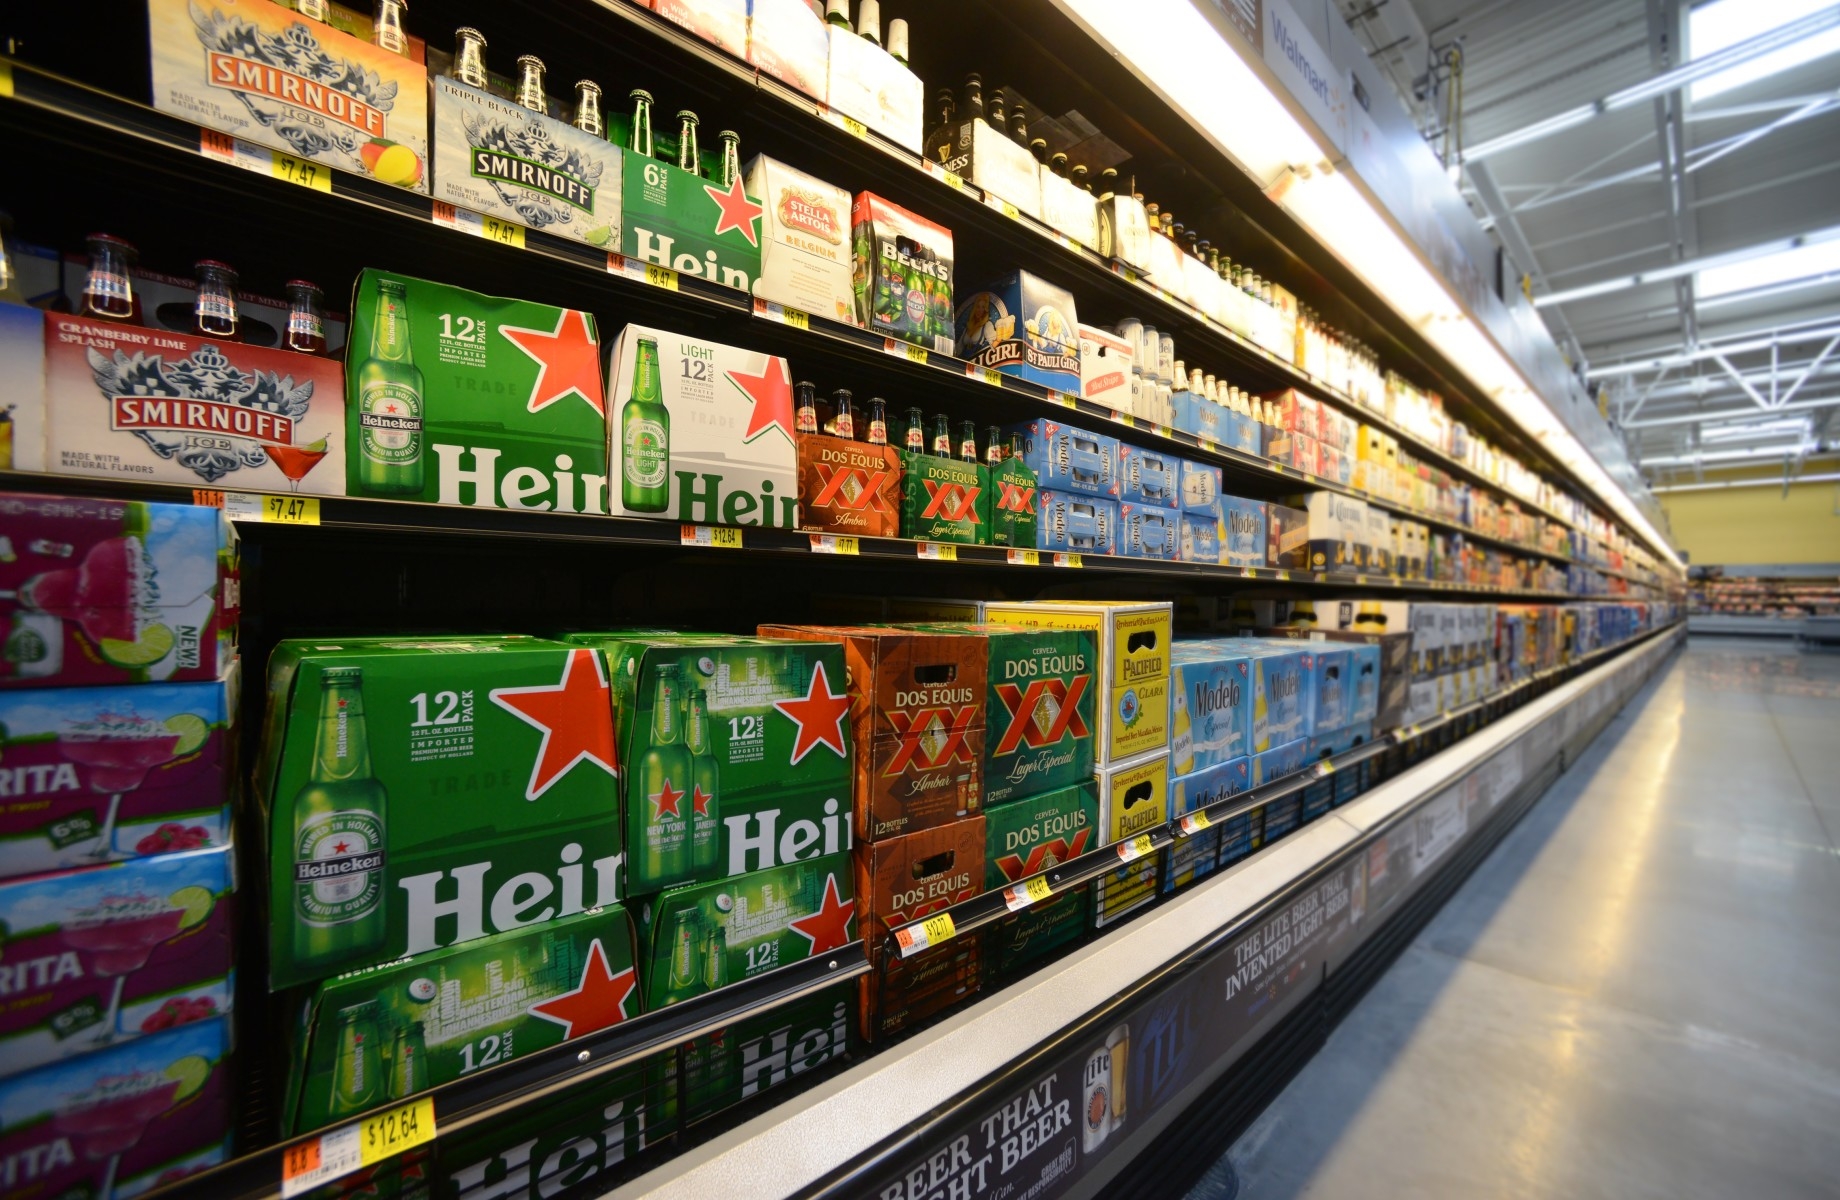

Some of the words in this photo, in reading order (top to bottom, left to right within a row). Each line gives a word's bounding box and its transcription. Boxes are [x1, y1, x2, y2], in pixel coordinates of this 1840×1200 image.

[661, 6, 696, 34] Berries
[1270, 10, 1330, 107] Walmart
[216, 57, 381, 134] SMIRNOFF
[443, 84, 484, 106] TRIPLE
[487, 99, 524, 121] BLACK
[281, 104, 326, 129] ICE
[281, 157, 317, 187] $7.47
[477, 153, 590, 205] SMIRNOFF
[643, 163, 660, 186] 6
[660, 168, 668, 191] PACK
[521, 188, 551, 206] ICE
[790, 200, 831, 224] STELLA
[790, 211, 831, 235] ARTOIS
[488, 220, 515, 244] $7.47
[785, 234, 838, 261] BELGIUM
[58, 321, 152, 346] CRANBERRY
[154, 336, 188, 351] LIME
[58, 331, 117, 350] SPLASH
[438, 313, 476, 343] 12
[476, 319, 487, 345] PACK
[439, 346, 486, 359] IMPORTED
[681, 343, 714, 361] LIGHT
[985, 342, 1021, 366] GIRL
[1037, 353, 1061, 369] PAULI
[1060, 354, 1081, 374] GIRL
[680, 357, 707, 382] 12
[453, 375, 517, 396] TRADE
[121, 400, 288, 440] SMIRNOFF
[362, 414, 421, 430] Heineken
[690, 410, 735, 429] TRADE
[185, 434, 233, 450] ICE
[626, 446, 666, 459] Heineken
[1059, 433, 1070, 476] Modelo
[60, 450, 92, 462] MADE
[94, 453, 121, 463] WITH
[60, 458, 108, 471] NATURAL
[111, 461, 155, 475] FLAVORS
[821, 448, 848, 464] DOS
[850, 454, 885, 470] EQUIS
[1101, 445, 1109, 485] Modelo
[928, 466, 949, 481] DOS
[951, 471, 979, 485] EQUIS
[1003, 473, 1015, 486] DOS
[1014, 475, 1035, 488] EQUIS
[1131, 455, 1140, 492] Modelo
[811, 462, 889, 514] XX
[919, 478, 982, 525] XX
[996, 480, 1036, 514] XX
[270, 498, 305, 521] $7.47
[830, 512, 869, 527] Ambar
[1056, 500, 1066, 544] Modelo
[1229, 509, 1262, 536] Modelo
[946, 523, 972, 537] Especial
[1097, 507, 1106, 548] Modelo
[1132, 514, 1141, 553] Modelo
[179, 625, 198, 669] NEW!
[1032, 647, 1058, 656] CERVEZA
[1005, 659, 1038, 680] DOS
[1041, 654, 1086, 675] EQUIS
[1122, 657, 1162, 681] PACIFICO
[895, 690, 928, 708] DOS
[931, 687, 974, 705] EQUIS
[1138, 686, 1164, 701] CLARA
[1194, 678, 1241, 720] Modelo
[409, 690, 460, 728] 12
[461, 689, 474, 723] PACK
[663, 696, 671, 734] Heineken
[992, 673, 1093, 758] XX
[335, 710, 347, 758] Heineken
[443, 725, 474, 734] BOTTLES
[728, 715, 757, 741] 12
[756, 715, 764, 738] PACK
[881, 703, 980, 778] XX
[411, 736, 474, 749] IMPORTED
[1005, 753, 1040, 785] Lager
[1036, 746, 1077, 776] Especial
[429, 768, 513, 797] TRADE
[904, 773, 952, 797] Ambar
[986, 791, 996, 803] 12
[995, 786, 1013, 797] BOTTLES
[874, 822, 887, 836] 12
[886, 817, 909, 828] BOTTLES
[1034, 807, 1060, 821] CERVEZA
[1118, 805, 1159, 838] PACIFICO
[301, 825, 330, 855] BREWED
[332, 821, 344, 831] IN
[346, 820, 379, 845] HOLLAND
[646, 824, 665, 837] NEW
[666, 820, 687, 834] YORK
[723, 796, 853, 878] Hei
[1006, 825, 1040, 851] DOS
[1043, 808, 1086, 838] EQUIS
[298, 855, 382, 879] Heineken
[919, 872, 945, 886] CERVEZA
[302, 894, 342, 915] PREMIUM
[344, 882, 378, 912] QUALITY
[892, 889, 925, 911] DOS
[928, 873, 970, 895] EQUIS
[925, 915, 948, 939] $12.77
[1234, 931, 1262, 968] THE
[1263, 910, 1291, 947] LITE
[1291, 891, 1319, 927] BEER
[1320, 871, 1345, 903] THAT
[744, 942, 772, 972] 12
[771, 938, 779, 962] PACK
[1225, 932, 1292, 1001] INVENTED
[1293, 906, 1326, 947] LIGHT
[1325, 887, 1349, 921] BEER
[459, 987, 528, 1019] AMSTERDAM
[457, 1034, 502, 1075] 12
[502, 1029, 513, 1059] PACK
[1085, 1053, 1110, 1089] Lite
[980, 1072, 1058, 1150] THAT
[367, 1106, 419, 1147] $12.64
[1000, 1098, 1072, 1176] BEER
